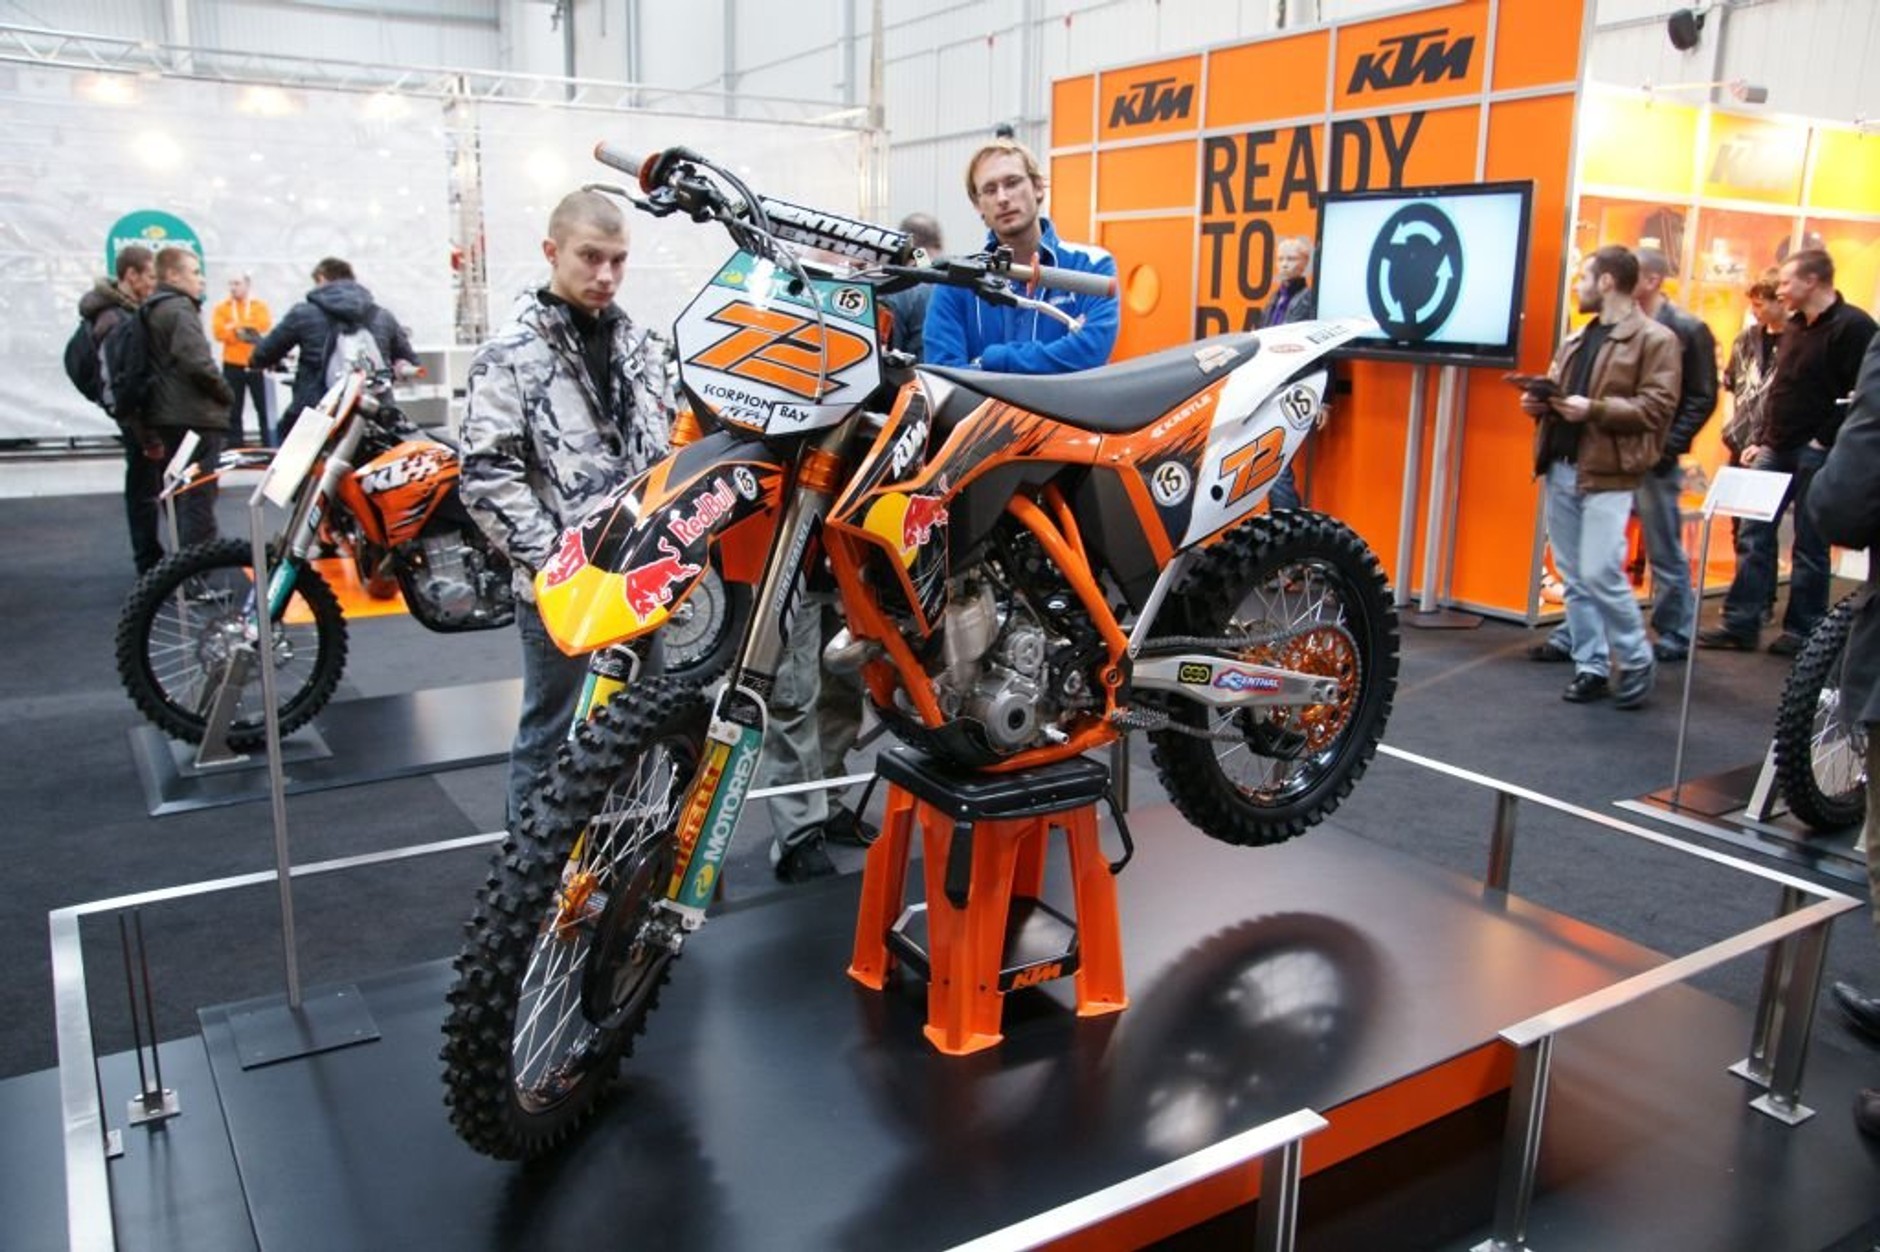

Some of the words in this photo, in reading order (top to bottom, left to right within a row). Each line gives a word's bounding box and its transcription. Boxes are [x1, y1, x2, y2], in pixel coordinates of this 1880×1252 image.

[1346, 28, 1475, 95] KTM
[1108, 77, 1195, 128] KTM
[1202, 111, 1426, 216] READY
[1202, 218, 1275, 300] TO
[686, 299, 872, 402] 72
[703, 383, 773, 411] SCORPION
[780, 406, 809, 424] BAY
[1219, 426, 1286, 509] 72
[703, 744, 760, 862] MOTOREX
[1011, 962, 1062, 990] KTM
